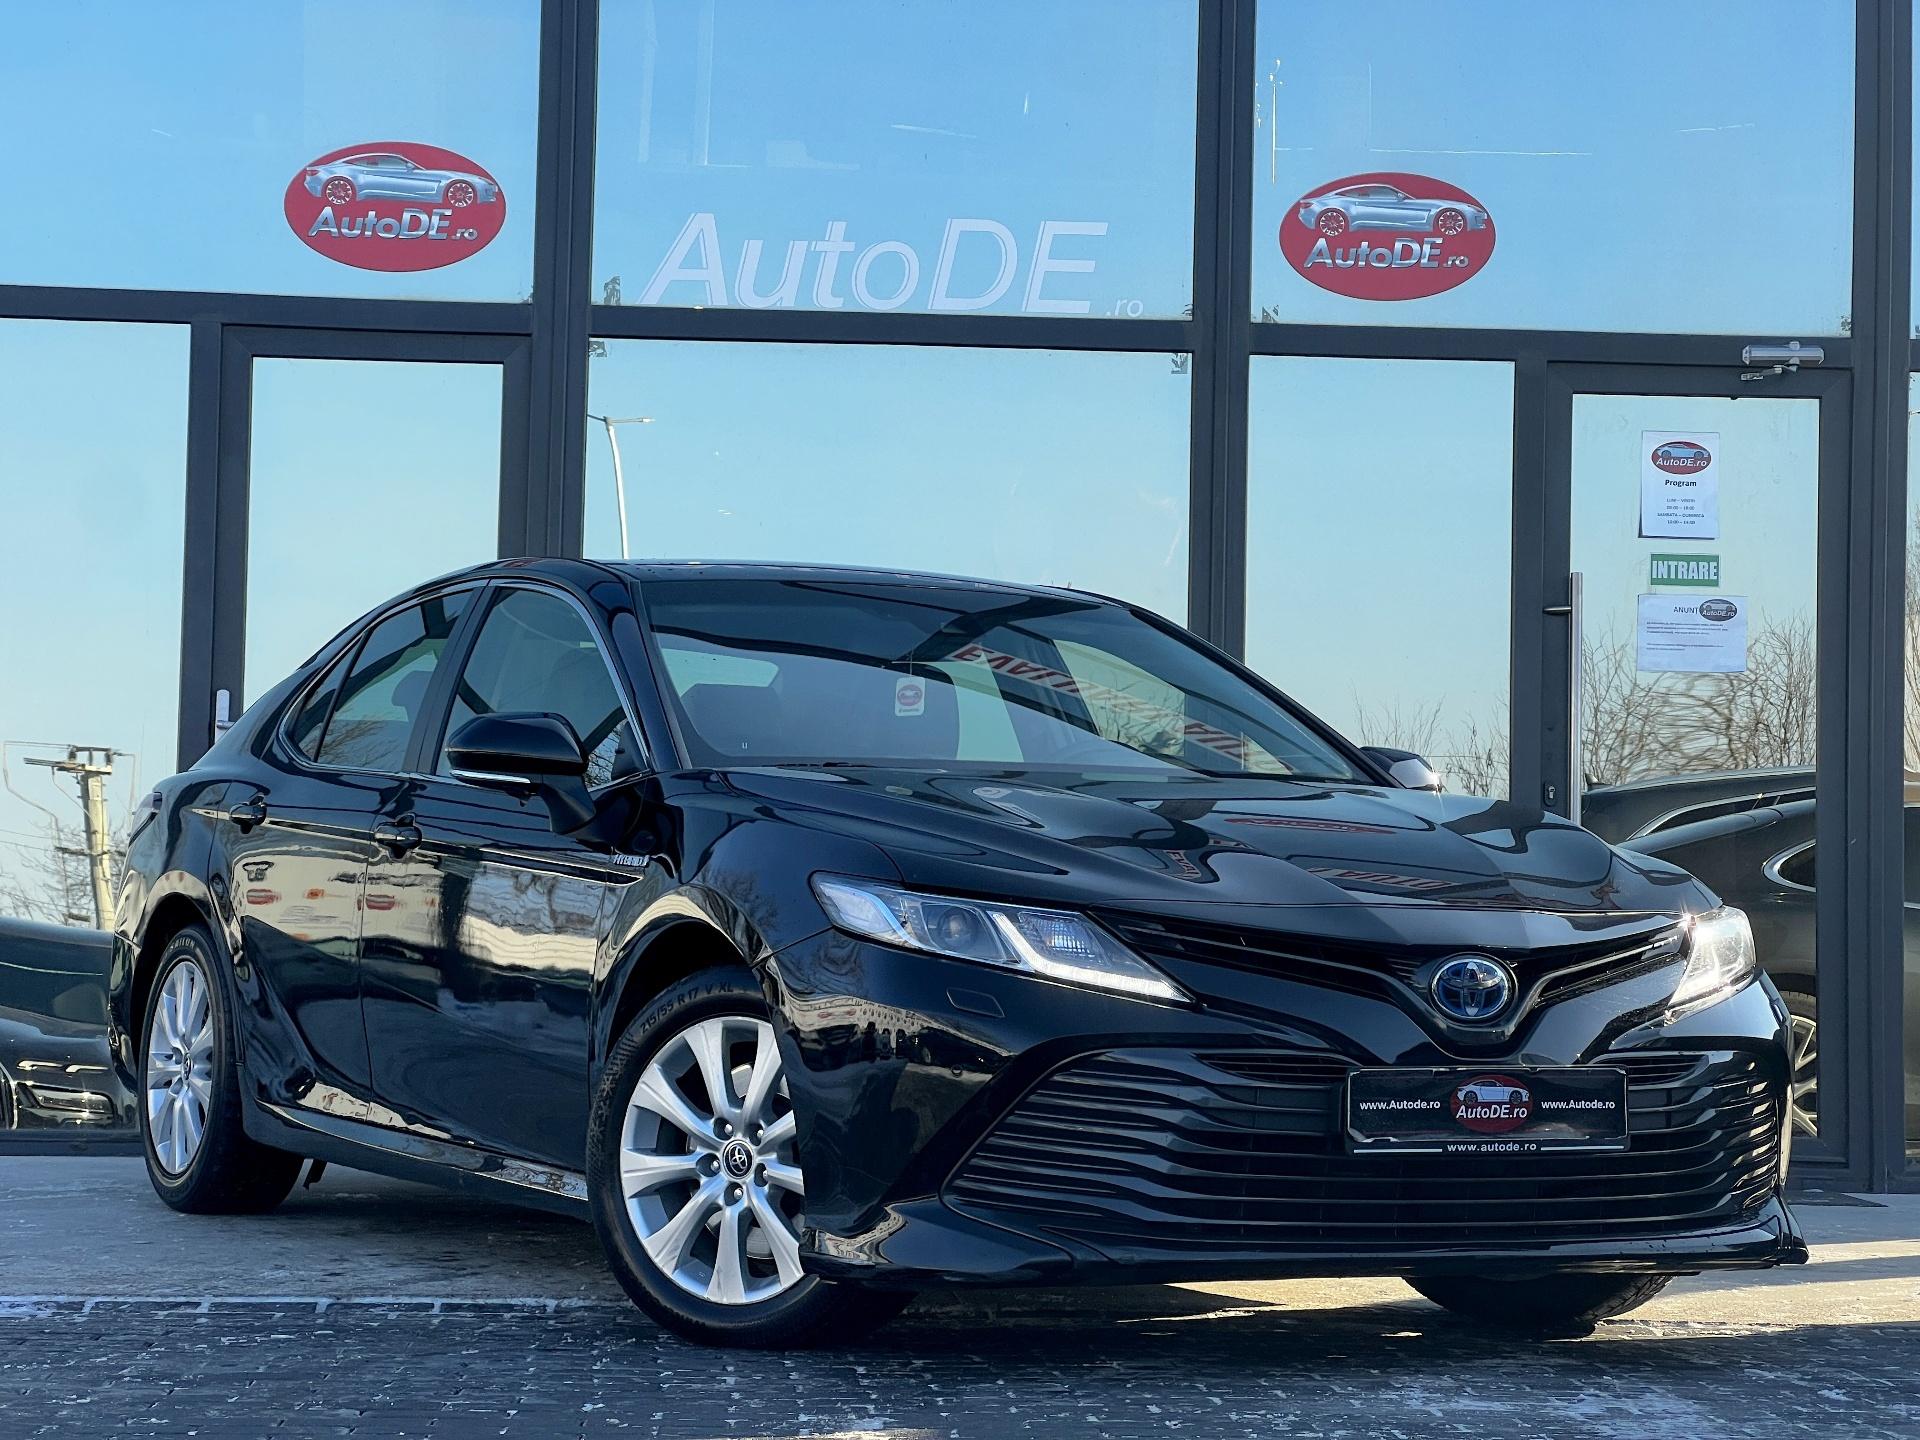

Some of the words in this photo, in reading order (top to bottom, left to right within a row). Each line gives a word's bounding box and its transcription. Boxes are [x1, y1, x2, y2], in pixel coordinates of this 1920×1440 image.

[1656, 457, 1708, 467] AutoDE.ro
[1664, 479, 1697, 487] Program
[1652, 560, 1718, 580] INTRARE
[640, 1000, 674, 1035] 215/55
[677, 993, 686, 1006] R
[687, 987, 700, 1001] 17
[719, 981, 734, 993] XL
[1359, 1099, 1441, 1110] www.Autode.ro
[1541, 1099, 1616, 1110] www.Autode.ro
[1455, 1104, 1528, 1119] AutoDE.ro
[1447, 1141, 1537, 1152] www.autode.ro
